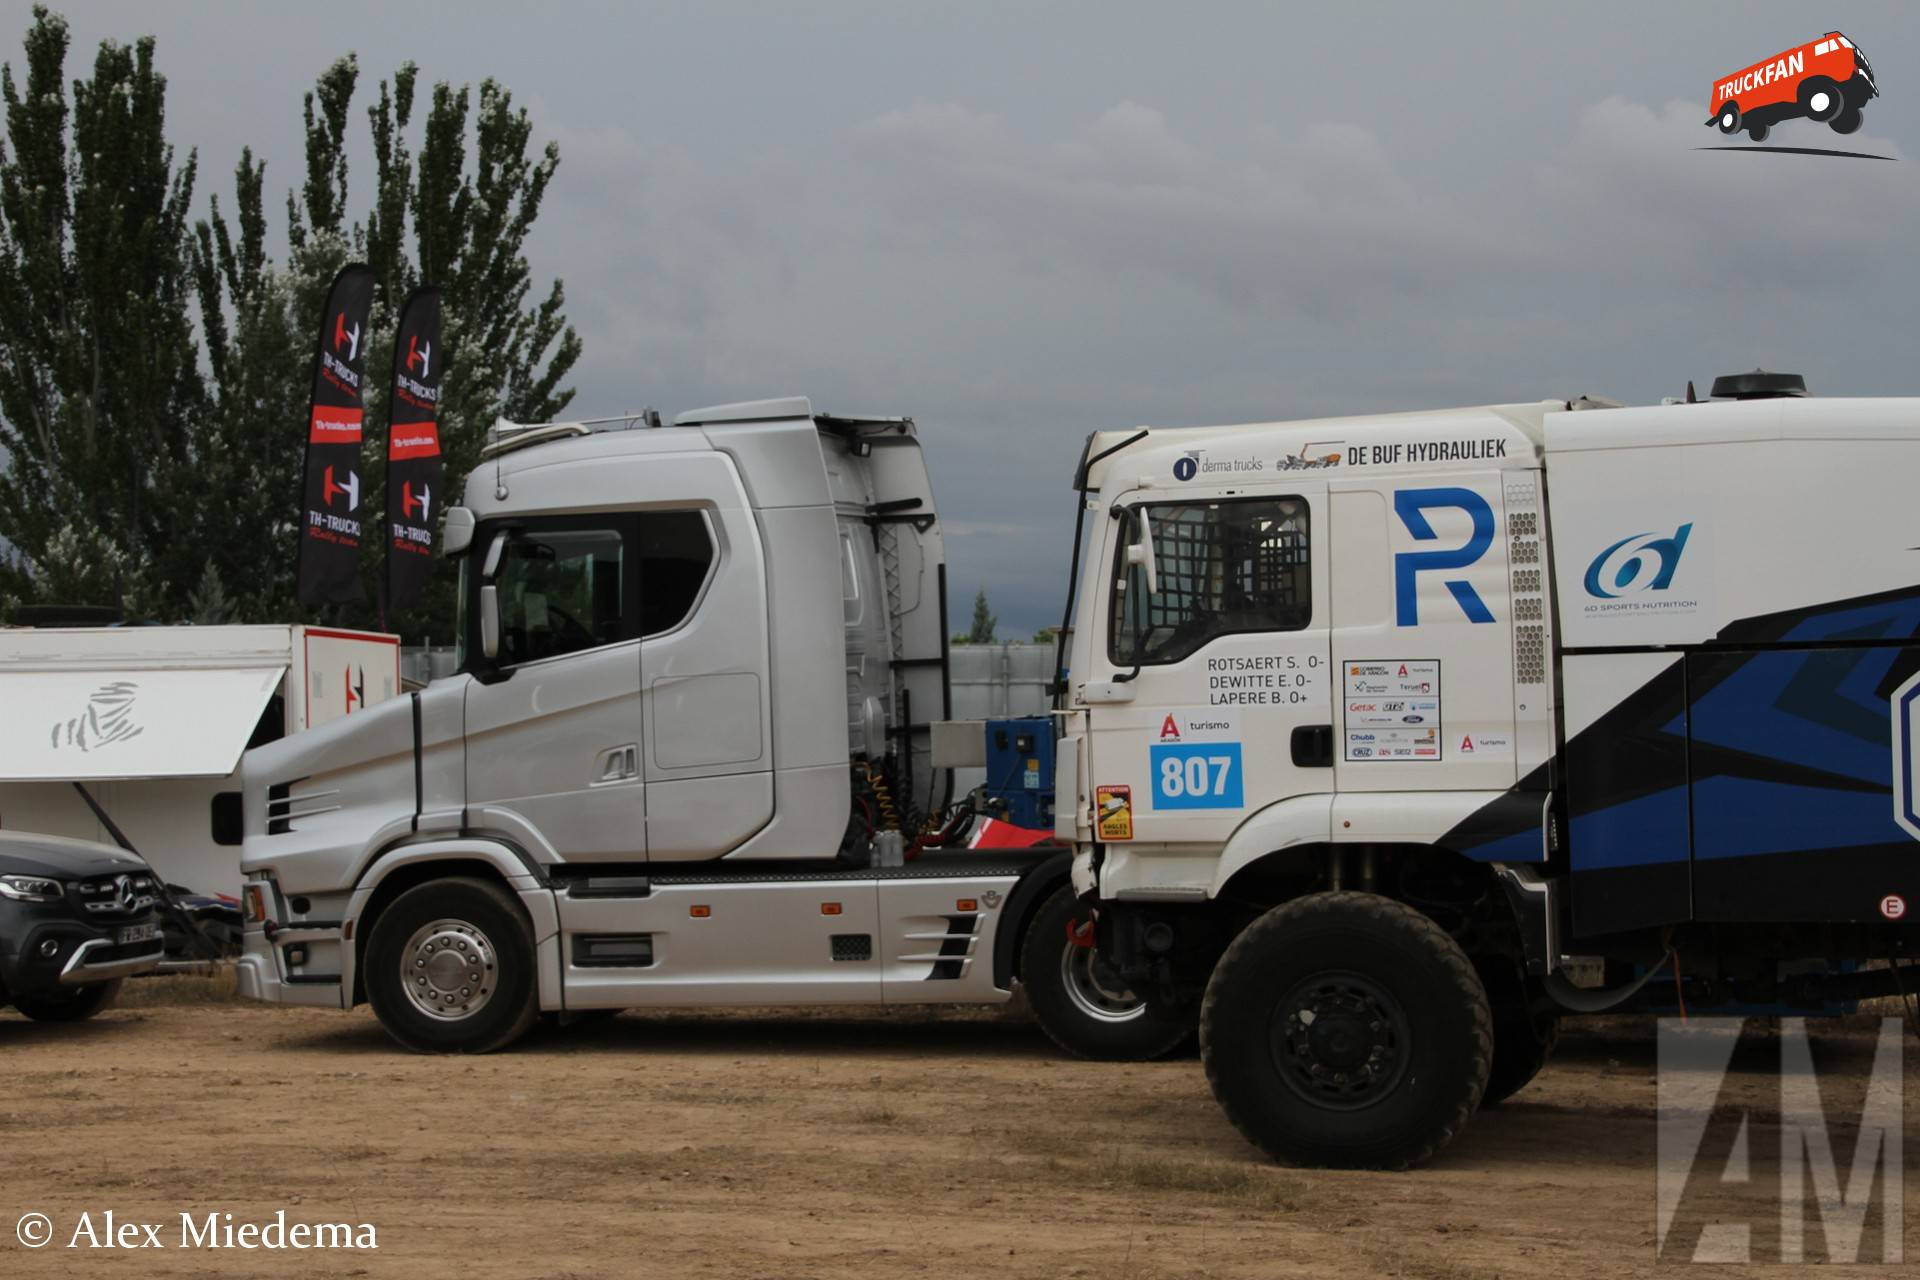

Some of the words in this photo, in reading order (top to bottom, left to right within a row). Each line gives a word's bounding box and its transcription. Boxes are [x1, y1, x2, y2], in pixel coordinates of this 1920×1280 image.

[1347, 446, 1368, 466] DE
[1372, 444, 1402, 464] BUF
[1407, 438, 1507, 463] HYDRAULIEK
[1201, 457, 1232, 473] derma
[1234, 455, 1263, 472] trucks
[1600, 602, 1640, 612] SPORTS
[1642, 600, 1698, 609] NUTRITION
[1208, 656, 1282, 671] ROTSAERT
[1286, 656, 1300, 669] S.
[1209, 674, 1274, 689] DEWITTE
[1278, 674, 1291, 687] E.
[1210, 691, 1267, 705] LAPERE
[1271, 691, 1285, 704] B.
[1189, 720, 1230, 730] turismo
[1480, 738, 1506, 746] turismo
[1161, 756, 1232, 798] 807
[1886, 899, 1899, 914] E
